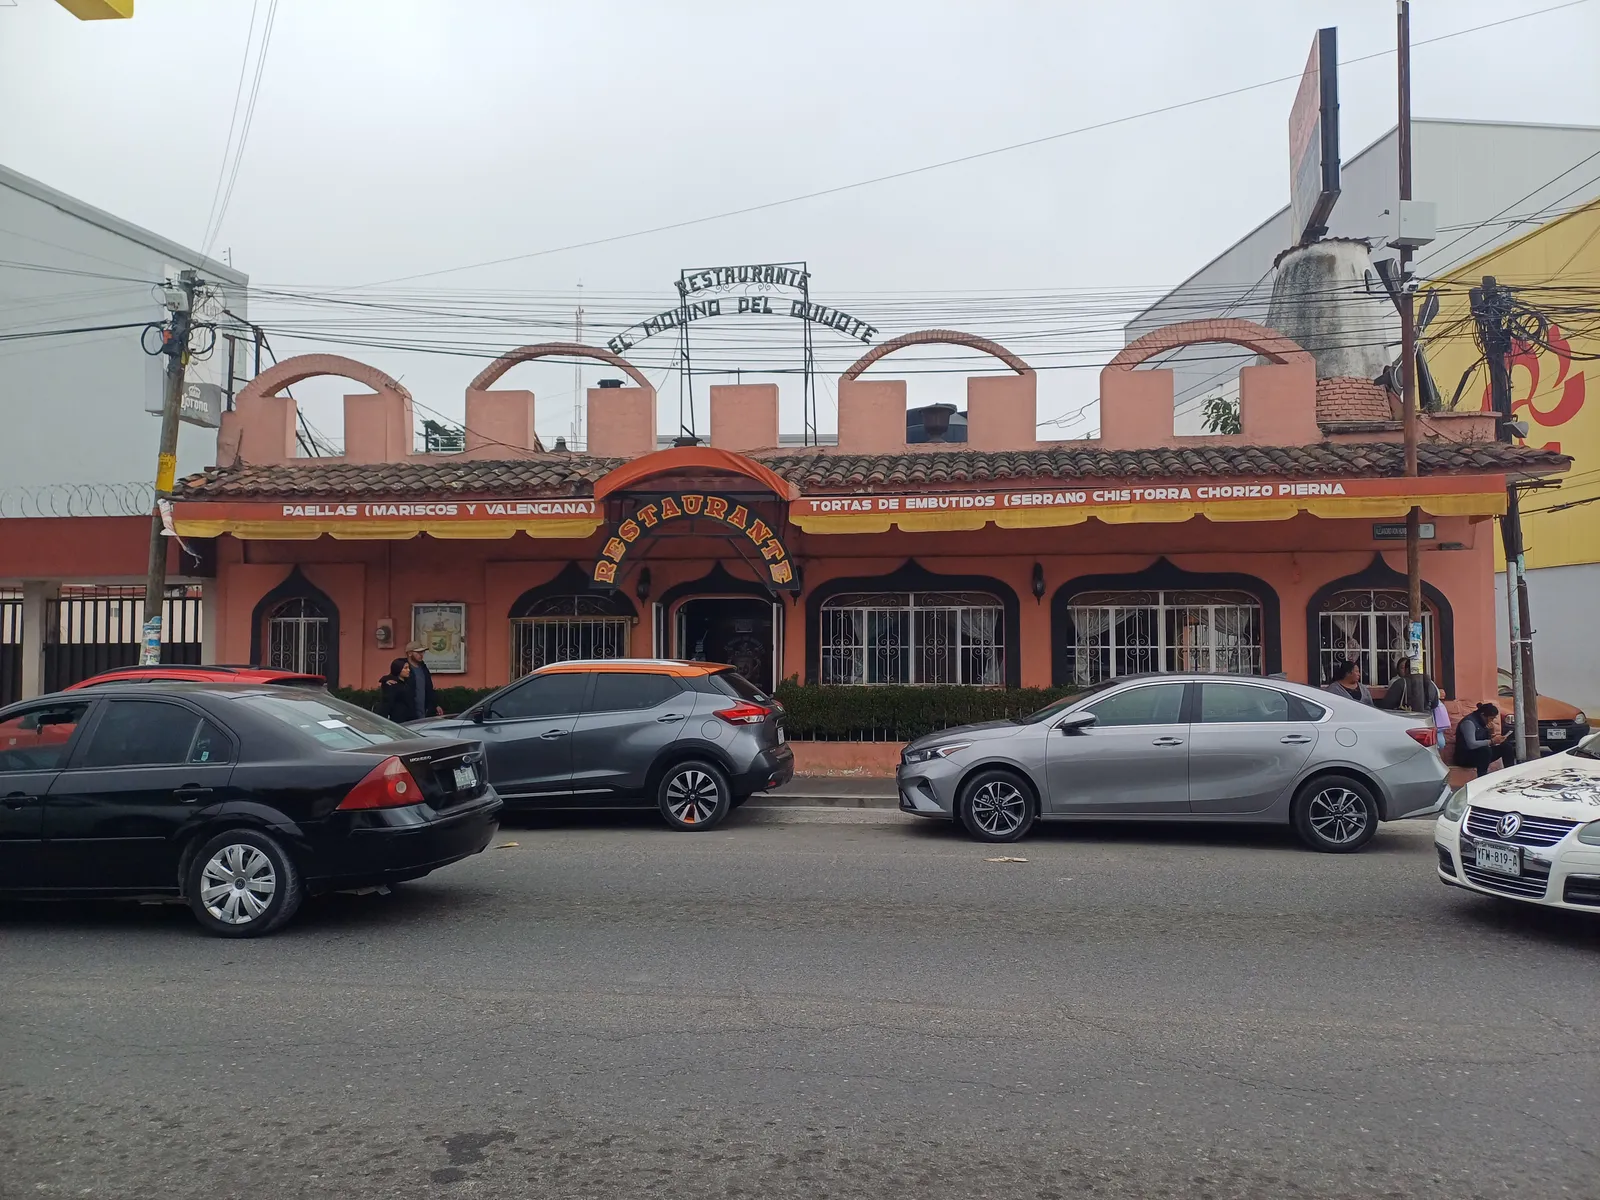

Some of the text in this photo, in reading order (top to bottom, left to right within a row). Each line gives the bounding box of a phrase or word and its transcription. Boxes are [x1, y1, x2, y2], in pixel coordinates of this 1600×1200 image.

[674, 264, 811, 297] RESTAURANTE
[606, 295, 880, 355] EL MOLINO DEL QUIJOTE
[180, 392, 209, 413] Corona
[282, 501, 596, 517] PAELLAS (MARISCOS Y VALENCIANA)
[810, 499, 872, 512] TORTAS
[878, 498, 900, 511] DE
[905, 495, 996, 510] EMBUTIDOS
[1003, 491, 1087, 507] (SERRANO
[1196, 485, 1273, 499] CHORIZO
[1278, 483, 1346, 496] PIERNA
[593, 494, 794, 585] RESTAURANTE
